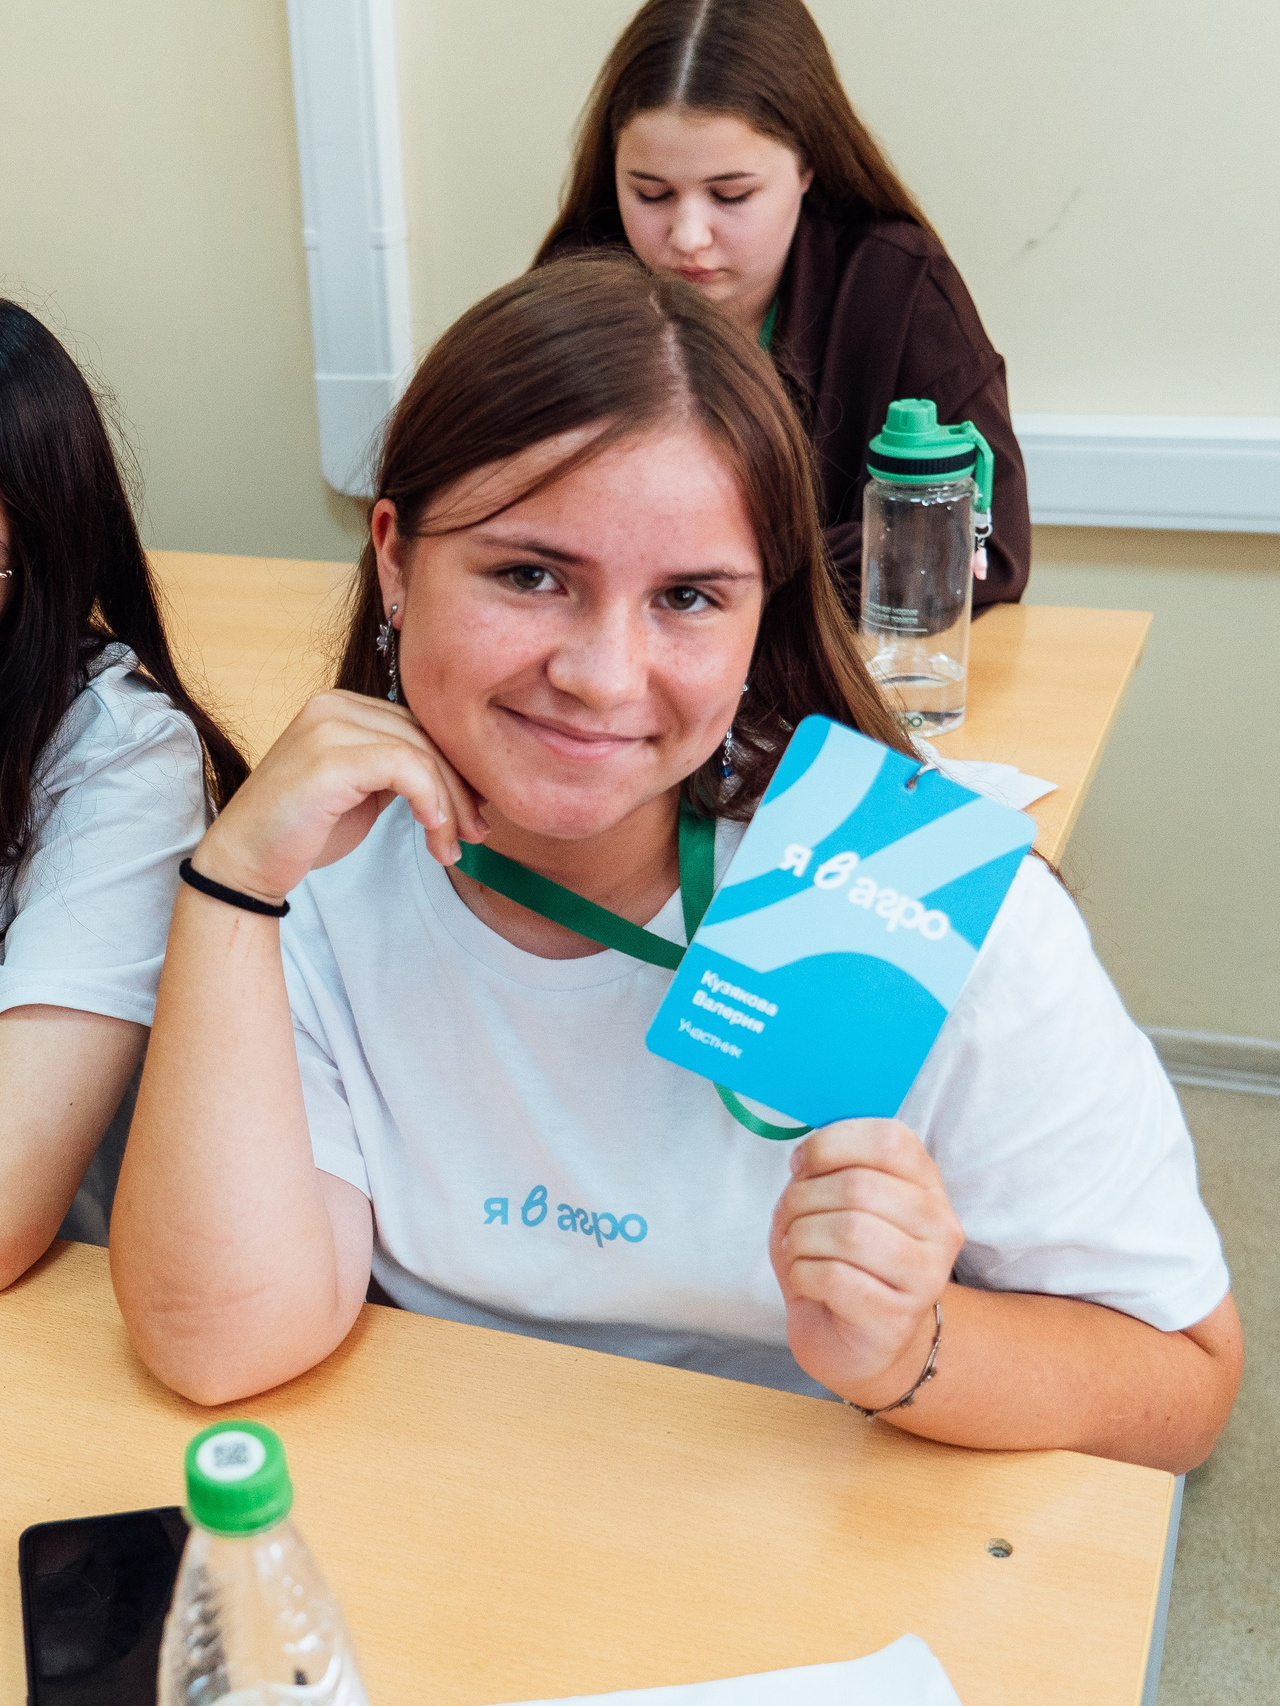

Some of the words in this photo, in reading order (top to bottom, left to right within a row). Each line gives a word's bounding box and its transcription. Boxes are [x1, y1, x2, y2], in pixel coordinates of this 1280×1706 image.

[847, 876, 951, 941] агро
[678, 1018, 743, 1059] Участник
[691, 989, 766, 1034] Валерия
[483, 1197, 508, 1225] я
[521, 1184, 548, 1227] в
[557, 1203, 648, 1249] агро
